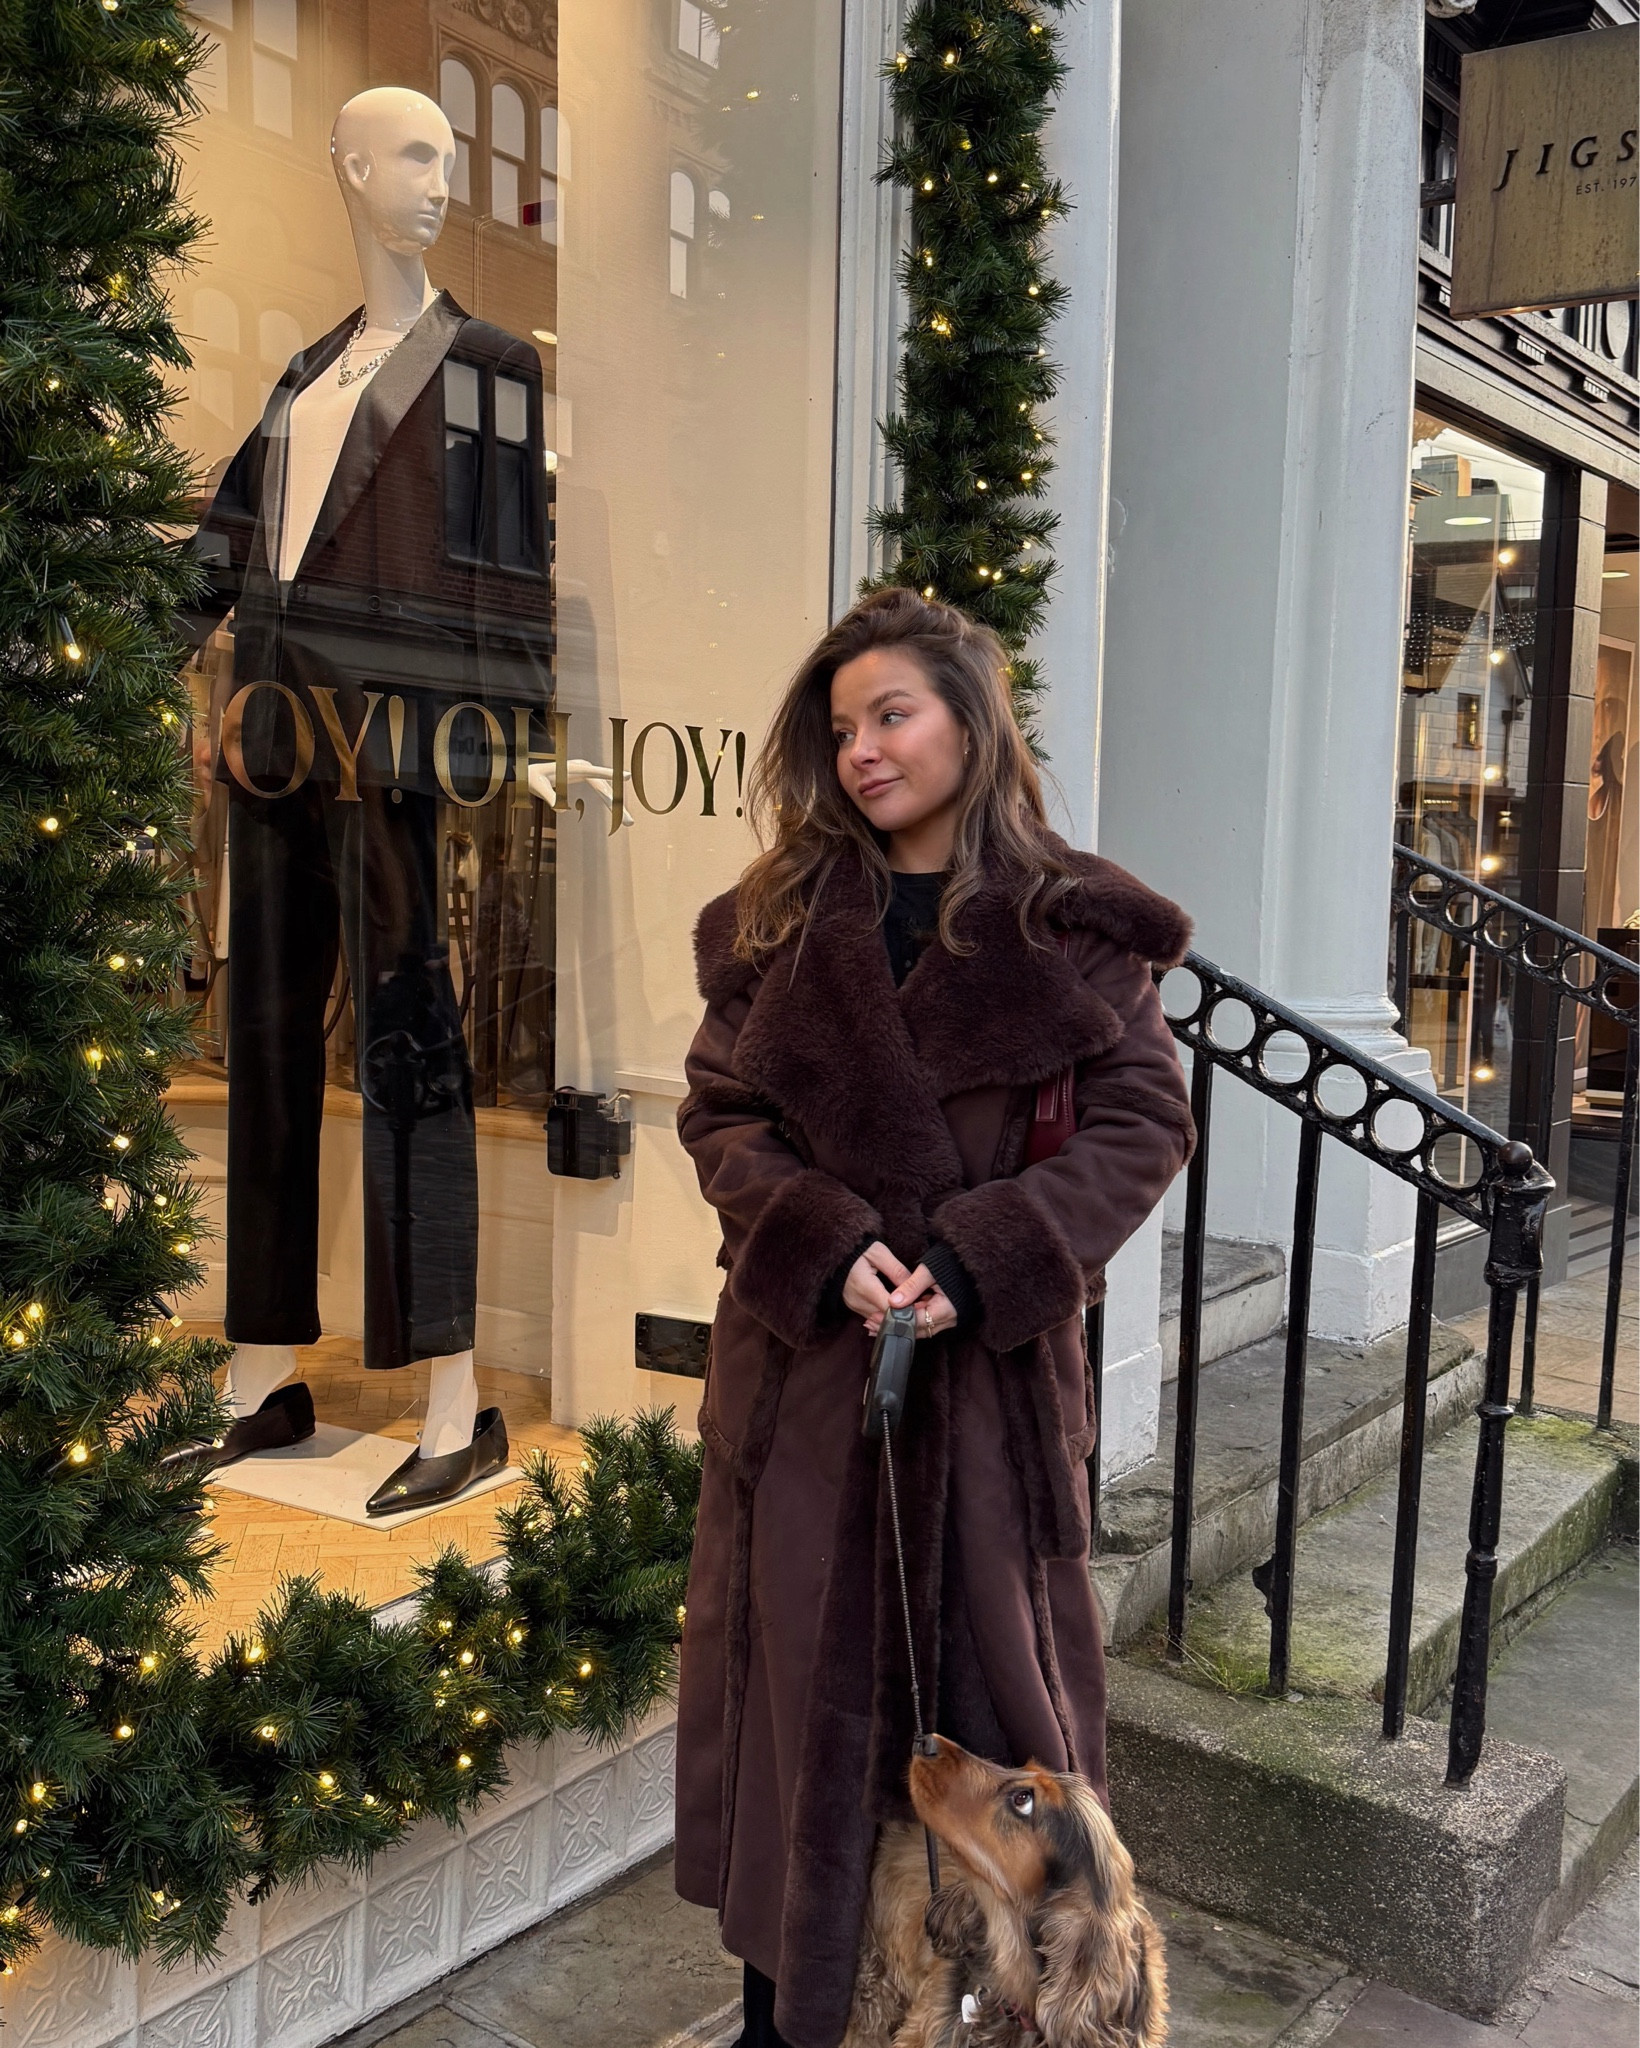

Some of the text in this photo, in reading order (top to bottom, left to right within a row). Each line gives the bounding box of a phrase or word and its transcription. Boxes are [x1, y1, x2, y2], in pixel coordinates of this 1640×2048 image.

[1576, 182, 1604, 195] EST.
[433, 702, 585, 823] OH,
[608, 717, 746, 837] JOY!
